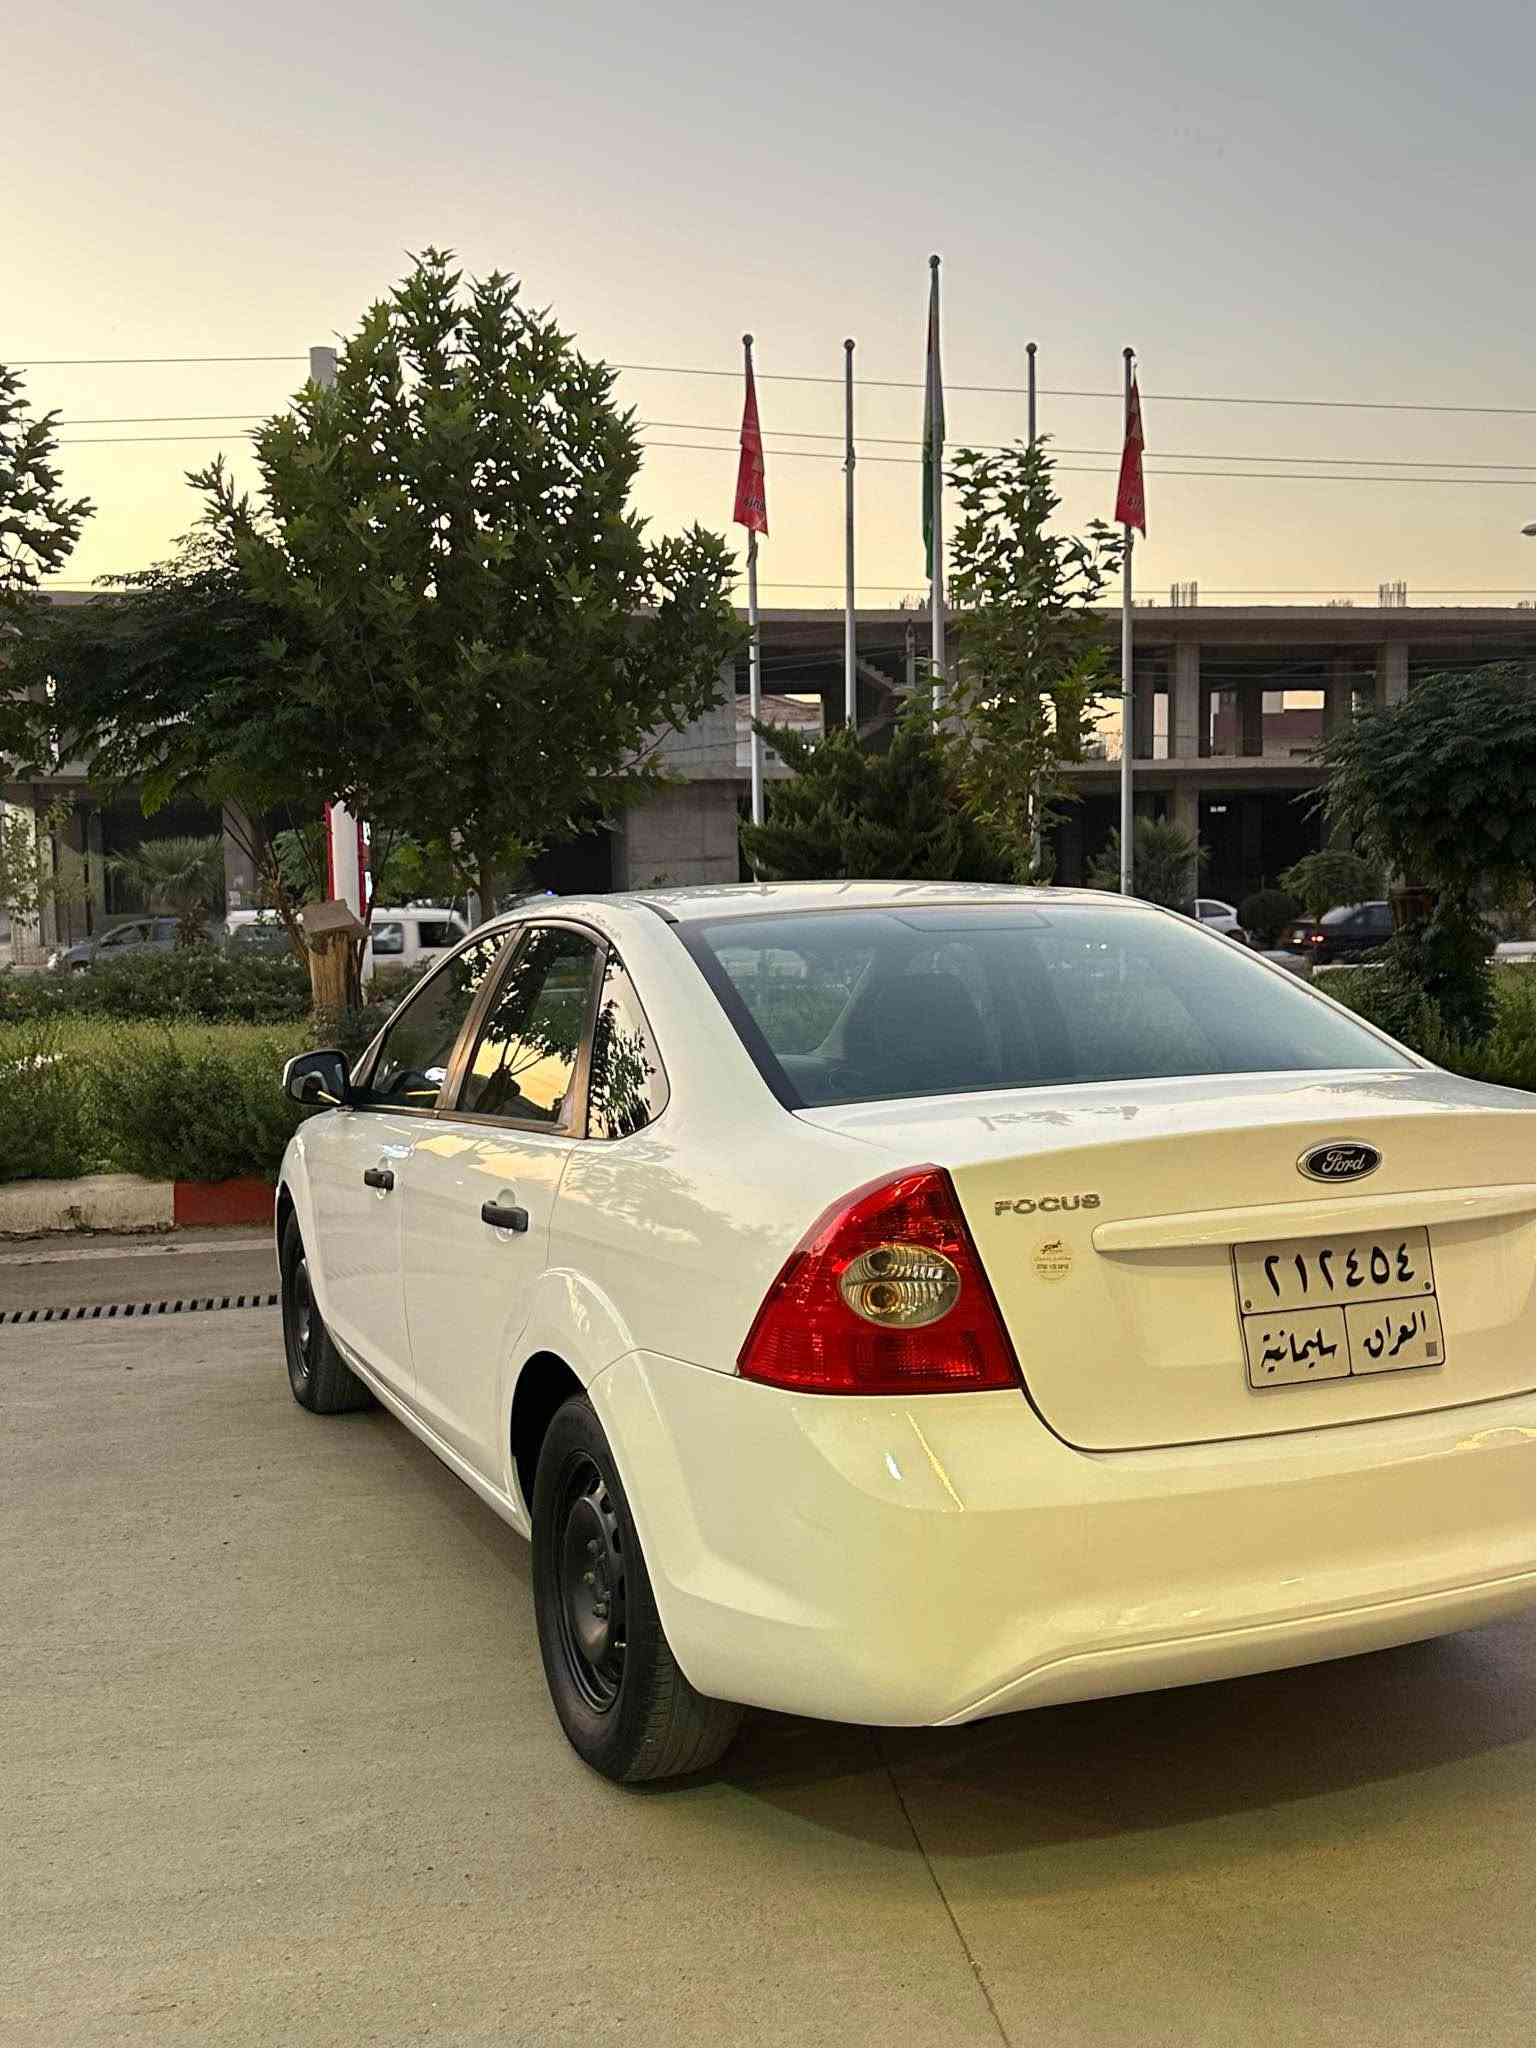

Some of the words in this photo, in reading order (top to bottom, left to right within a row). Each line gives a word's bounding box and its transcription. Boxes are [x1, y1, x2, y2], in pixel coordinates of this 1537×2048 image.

[1321, 1150, 1366, 1174] Ford
[994, 1193, 1101, 1216] FOCUS
[1264, 1242, 1415, 1297] ٢١٢٤٥٤
